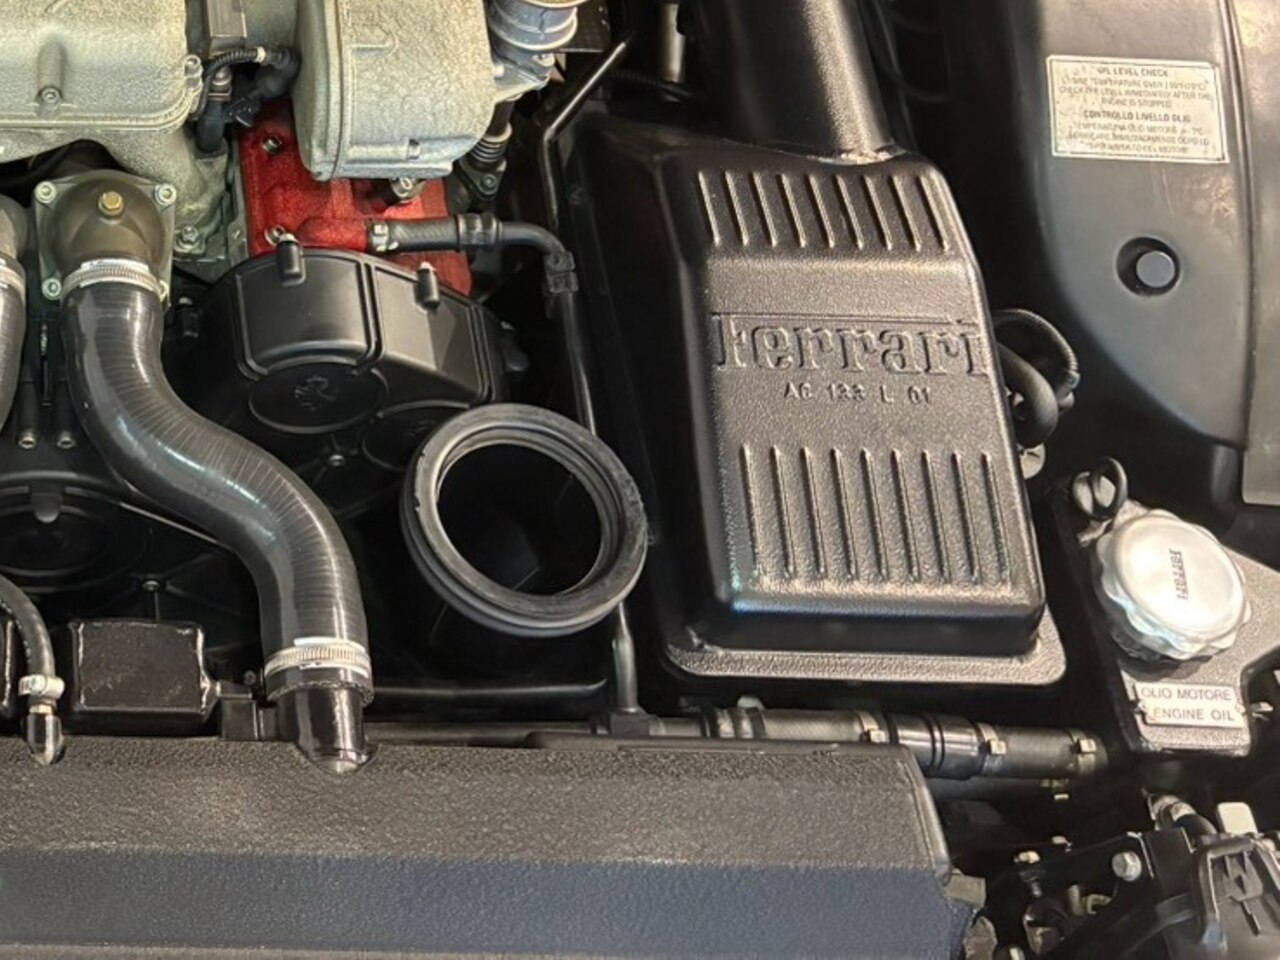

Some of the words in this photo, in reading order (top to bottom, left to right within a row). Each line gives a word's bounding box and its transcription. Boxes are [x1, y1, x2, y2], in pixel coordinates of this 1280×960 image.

[712, 312, 990, 377] Ferrari
[878, 384, 895, 403] L
[1140, 686, 1173, 700] OLIO
[1176, 688, 1232, 701] MOTORE
[1152, 706, 1205, 721] ENGINE
[1210, 708, 1236, 722] OIL
